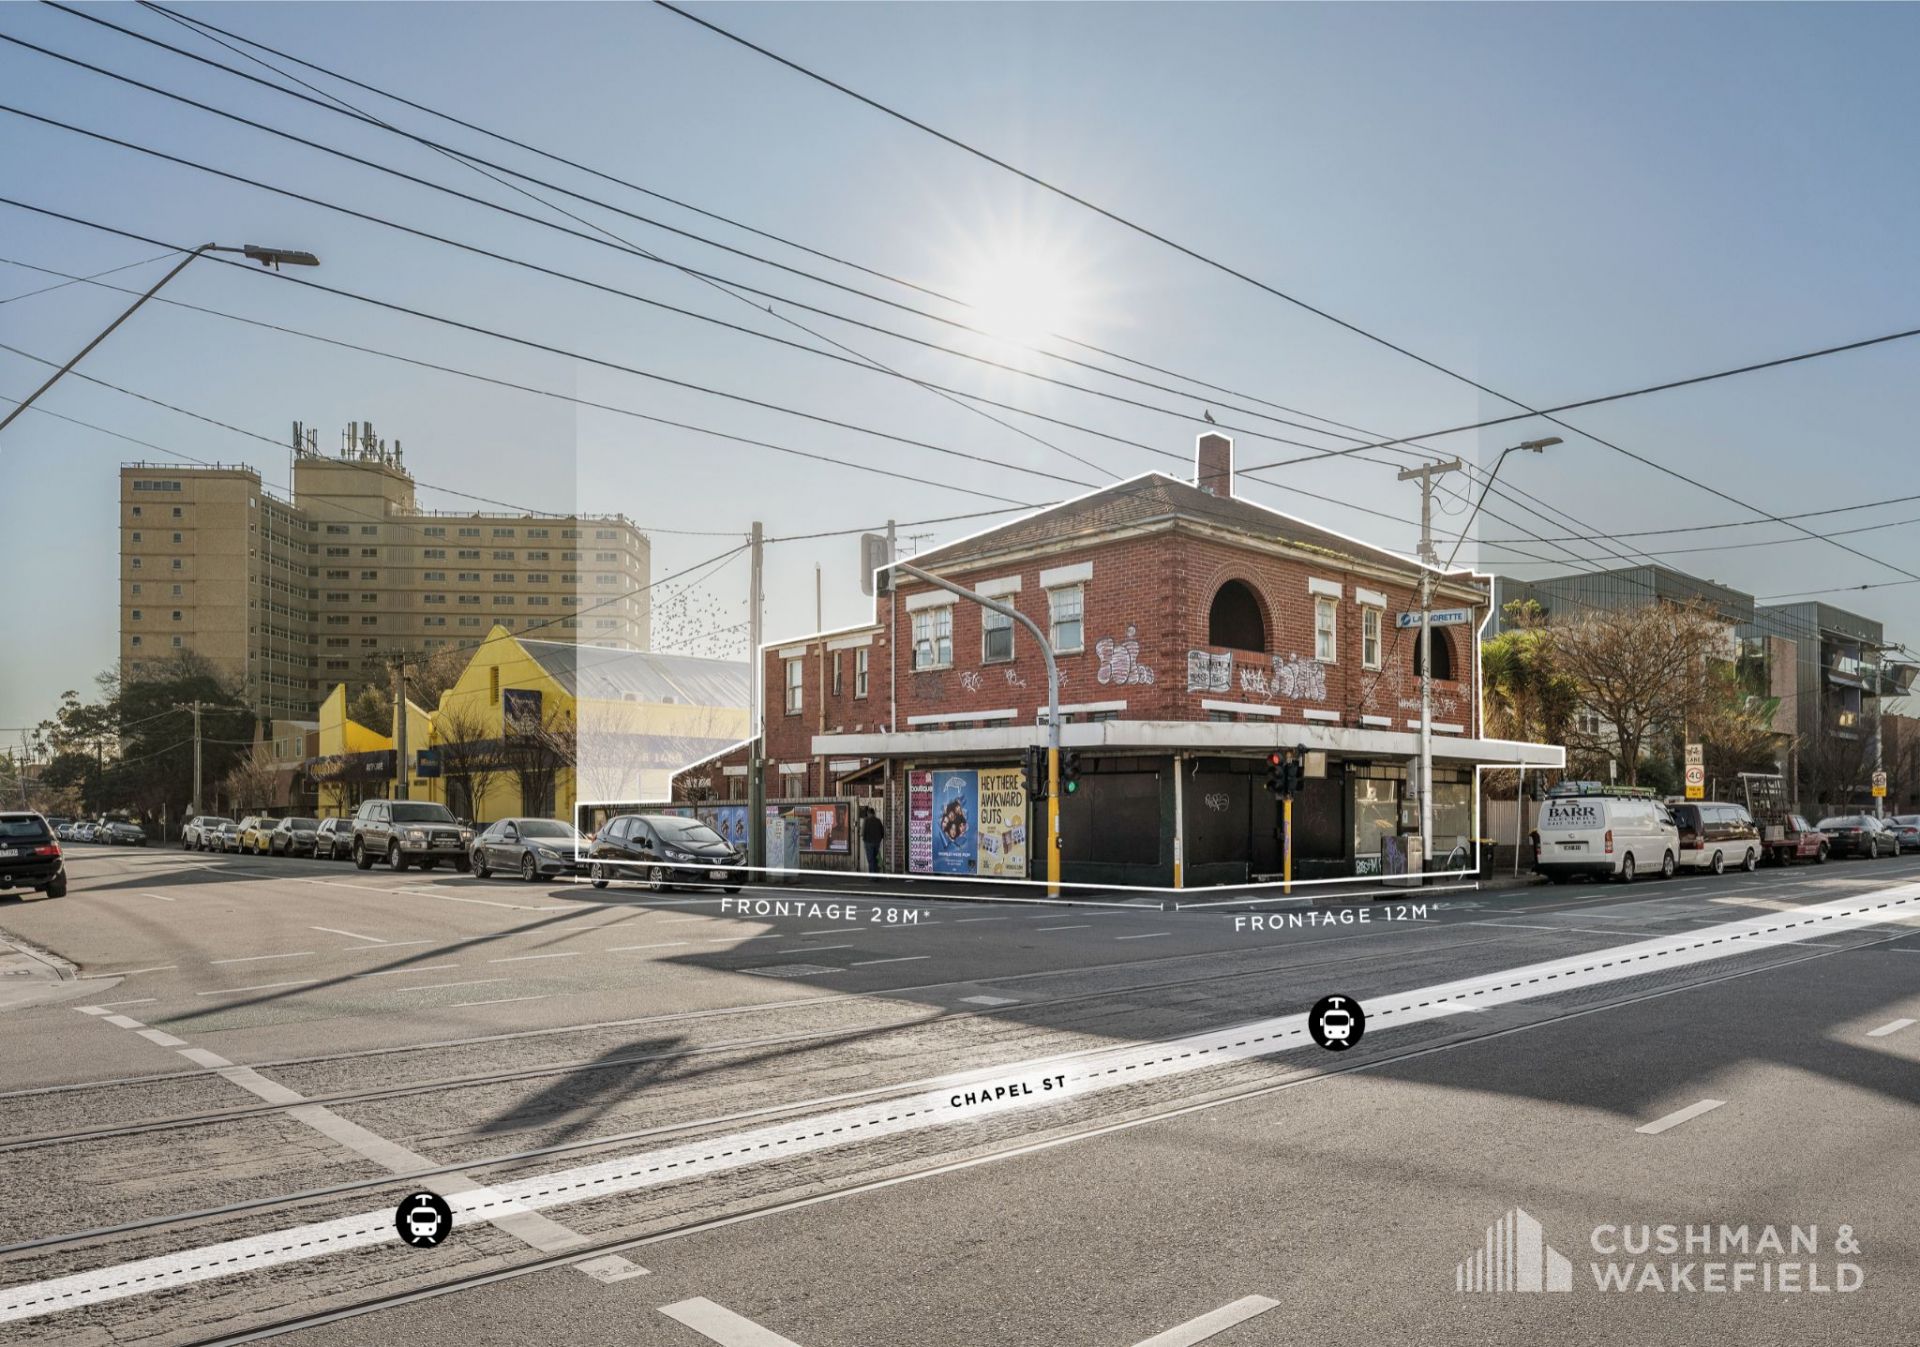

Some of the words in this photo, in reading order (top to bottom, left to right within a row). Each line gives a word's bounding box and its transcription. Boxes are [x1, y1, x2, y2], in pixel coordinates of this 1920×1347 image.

[981, 776, 997, 791] HEY
[997, 775, 1018, 790] THERE
[981, 792, 1022, 807] AWKWARD
[981, 809, 1002, 824] GUTS
[1549, 807, 1595, 817] BARR
